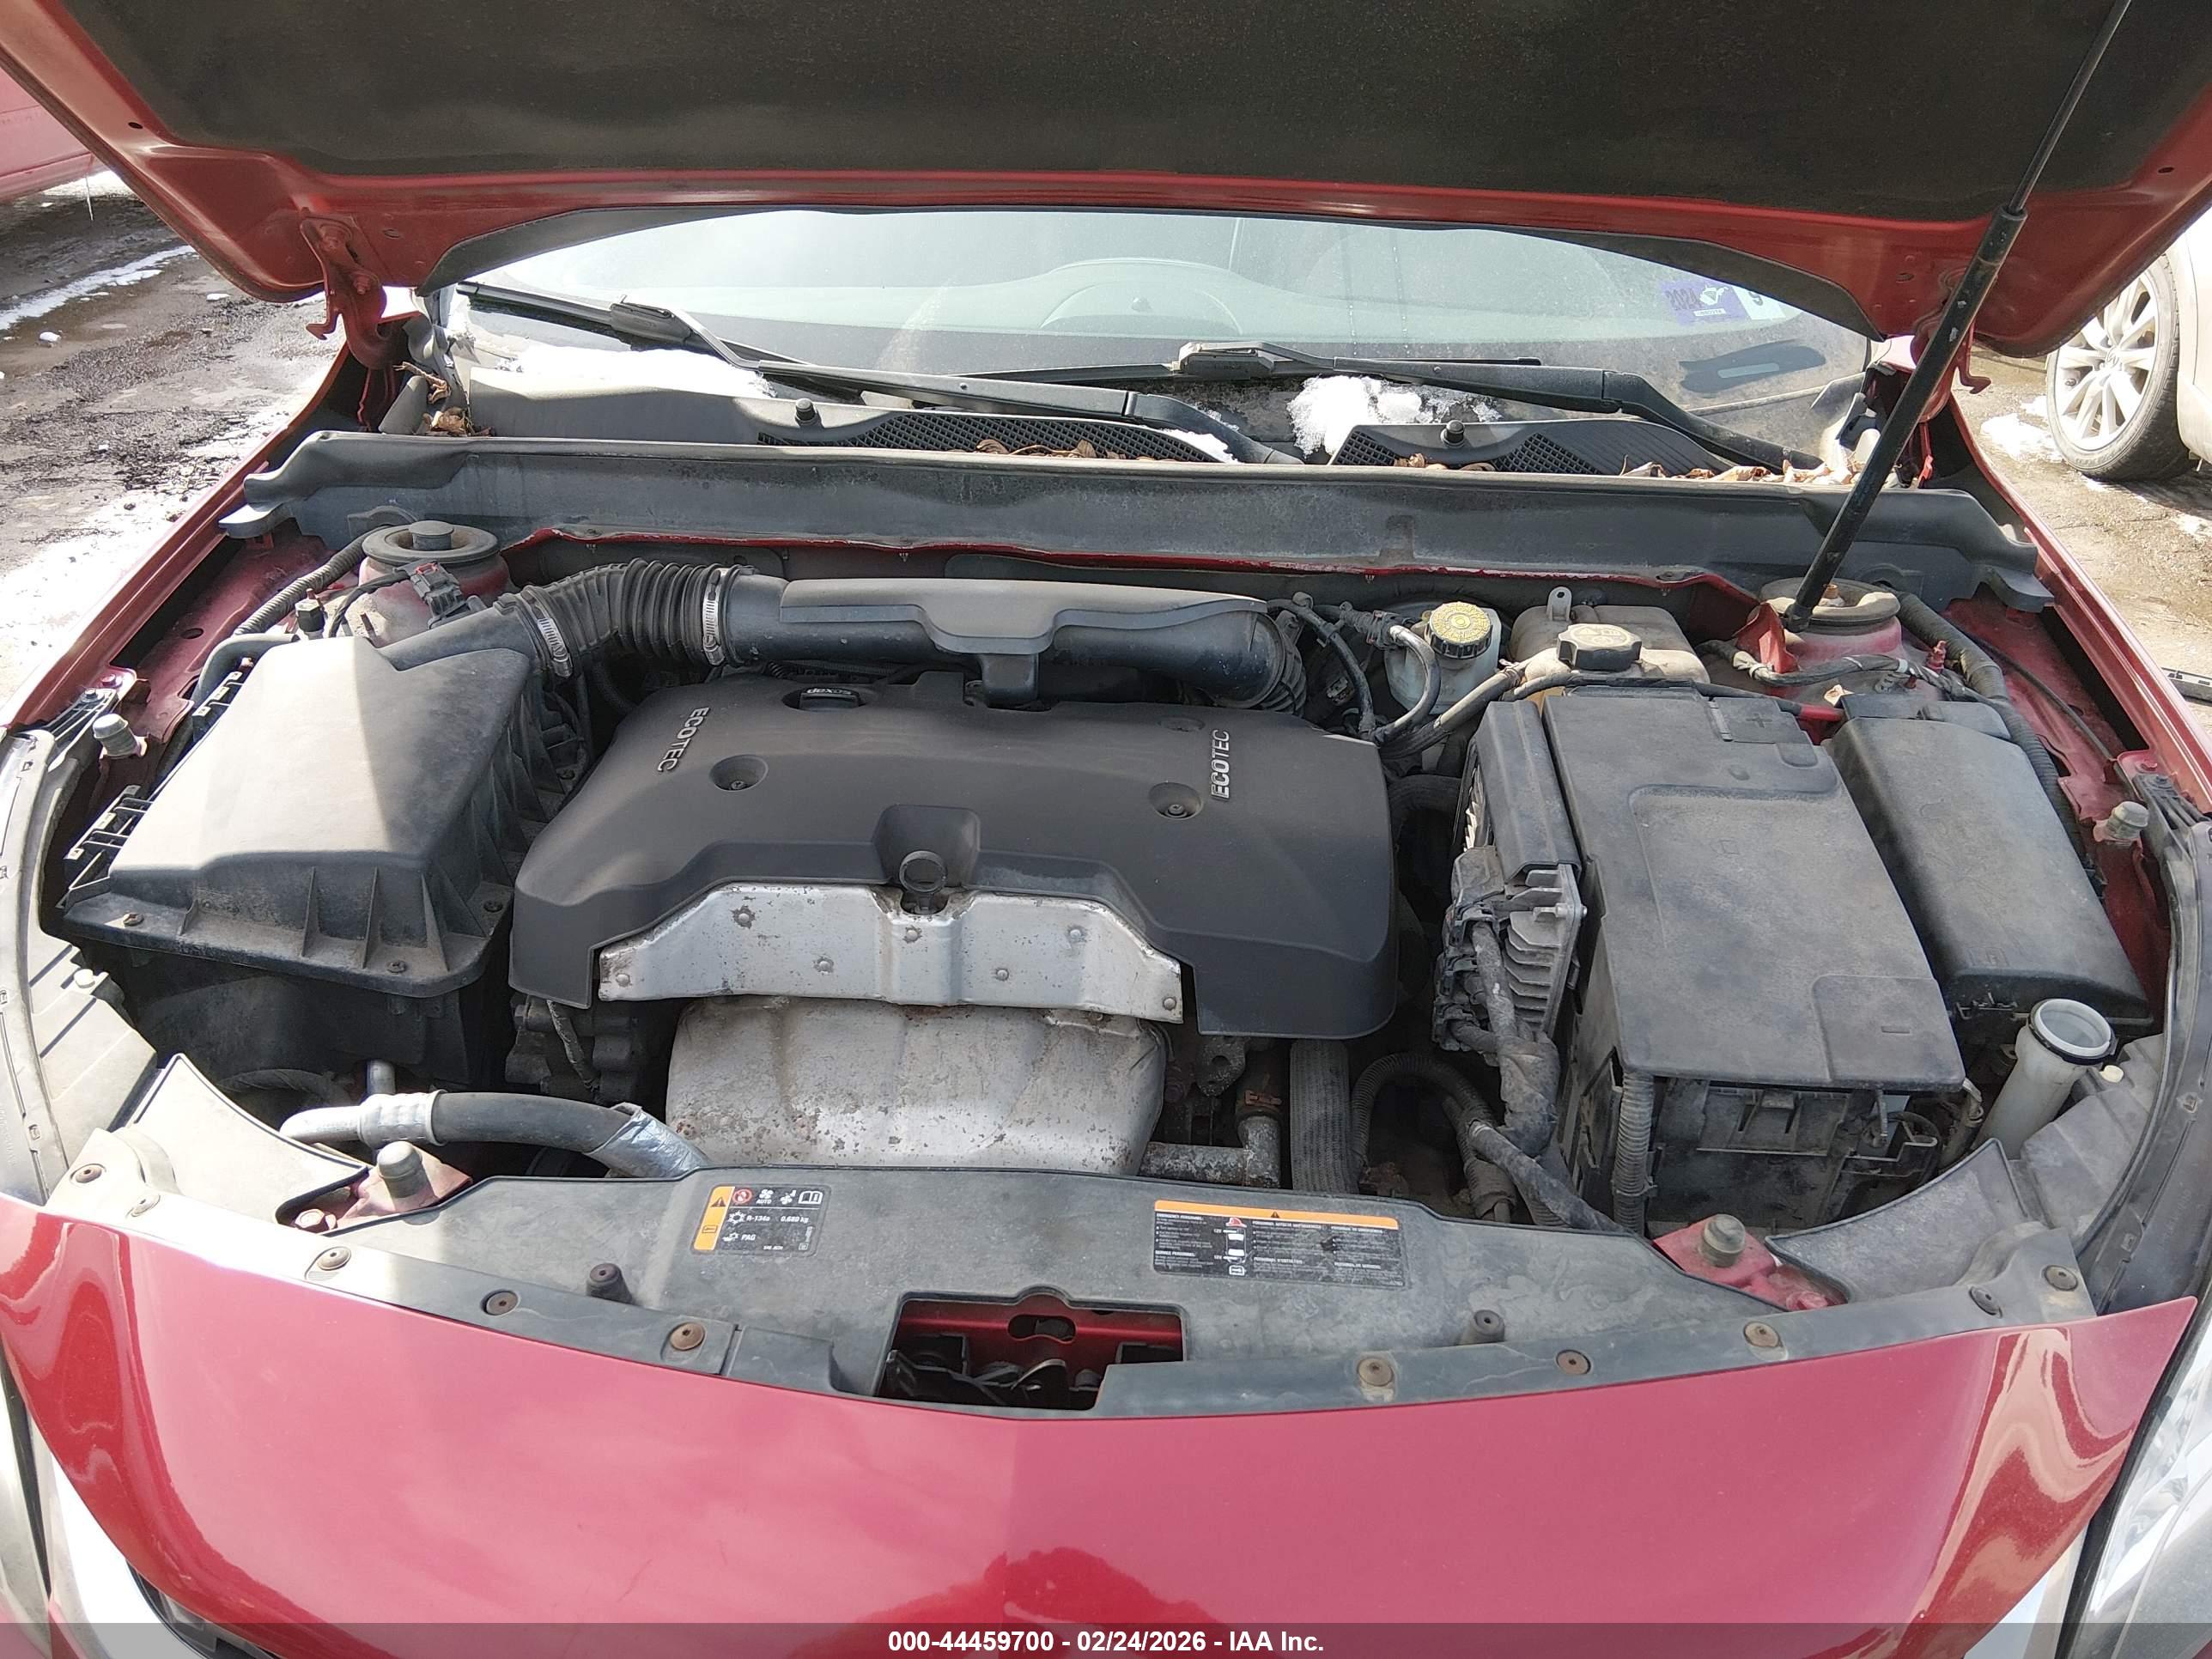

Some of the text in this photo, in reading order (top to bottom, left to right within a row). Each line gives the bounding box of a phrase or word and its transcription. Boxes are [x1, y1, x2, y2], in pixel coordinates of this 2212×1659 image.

[1665, 288, 1704, 310] 2024
[657, 707, 710, 771] ECOTEC
[1211, 729, 1230, 799] ECOTEC
